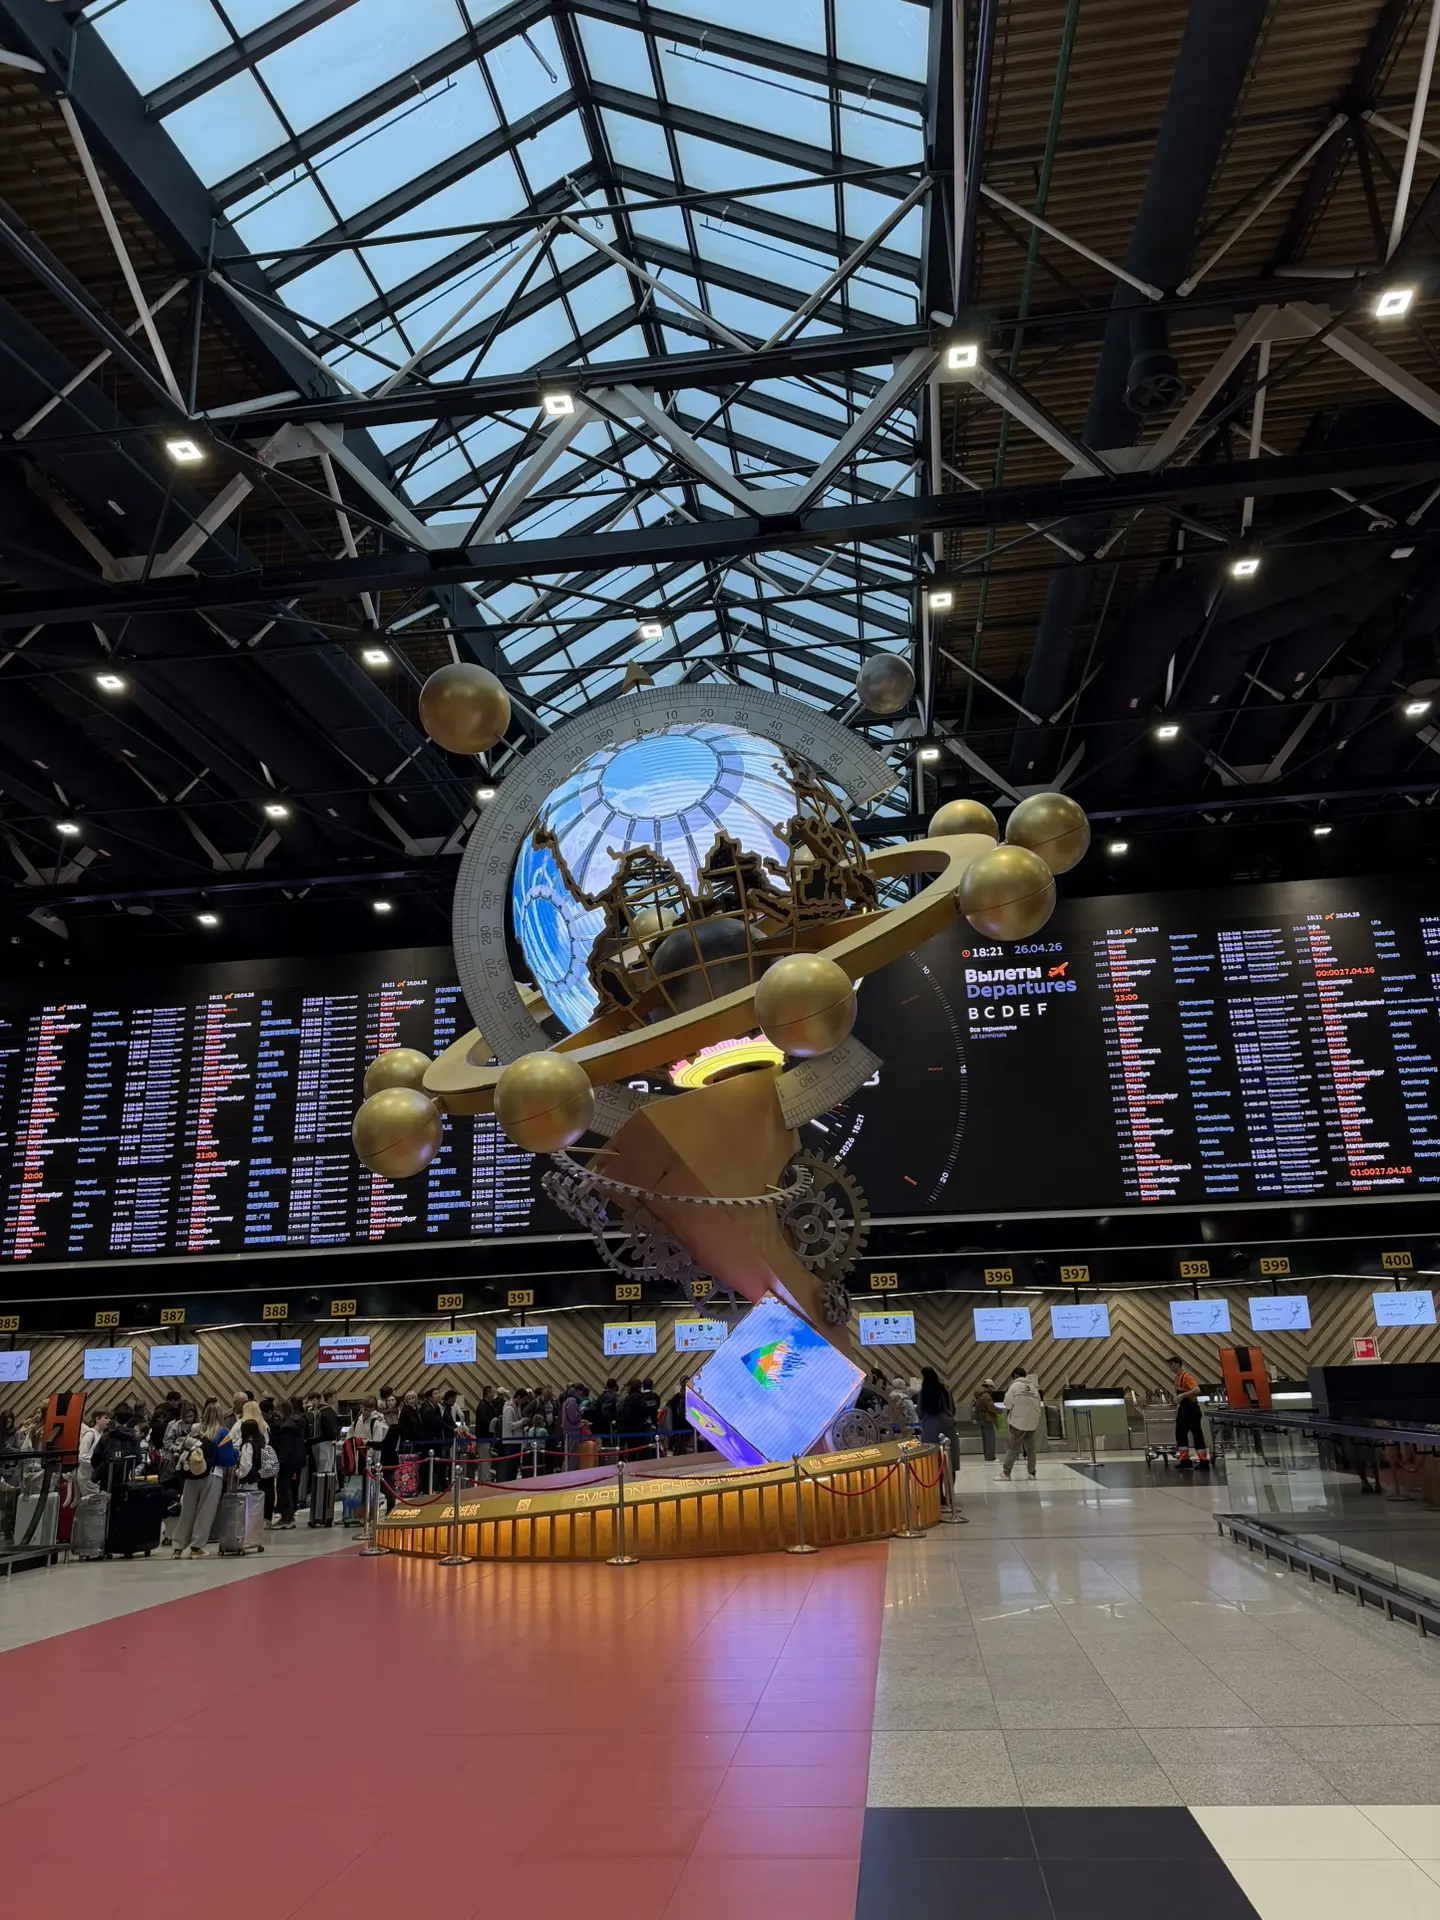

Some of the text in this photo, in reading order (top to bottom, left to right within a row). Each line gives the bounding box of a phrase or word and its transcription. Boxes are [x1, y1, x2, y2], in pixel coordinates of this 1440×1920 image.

[665, 710, 678, 719] 10
[700, 709, 714, 717] 20
[734, 711, 748, 721] 30
[634, 719, 641, 727] 0
[769, 720, 783, 731] 40
[594, 729, 614, 743] 350
[800, 733, 815, 745] 50
[563, 746, 583, 763] 340
[830, 753, 843, 766] 60
[538, 768, 557, 787] 330
[853, 775, 867, 789] 70
[516, 794, 533, 814] 320
[500, 823, 515, 843] 310
[487, 855, 500, 876] 300
[481, 889, 493, 910] 290
[480, 925, 491, 946] 280
[972, 942, 1063, 958] 18:21 26.04.26
[485, 958, 498, 978] 270
[922, 965, 930, 975] 10
[965, 966, 1042, 983] Вылеты
[966, 980, 1077, 1000] Departures
[497, 991, 512, 1012] 260
[1115, 994, 1138, 1002] 23:00
[968, 1003, 1047, 1020] B C D E F
[513, 1021, 531, 1041] 250
[960, 1064, 967, 1074] 15
[839, 1137, 855, 1156] 2026
[852, 1114, 865, 1134] 18:21
[196, 1151, 217, 1159] 21:00
[940, 1172, 949, 1184] 20
[1263, 1260, 1288, 1271] 399
[1385, 1255, 1410, 1266] 400
[1063, 1268, 1087, 1279] 397
[1183, 1263, 1208, 1275] 398
[872, 1275, 895, 1287] 395
[987, 1271, 1011, 1282] 396
[509, 1292, 531, 1303] 391
[618, 1286, 640, 1297] 392
[333, 1302, 355, 1314] 389
[440, 1296, 461, 1308] 390
[162, 1311, 184, 1322] 387
[265, 1306, 287, 1317] 388
[96, 1313, 118, 1324] 386
[575, 1485, 644, 1504] AVIATON
